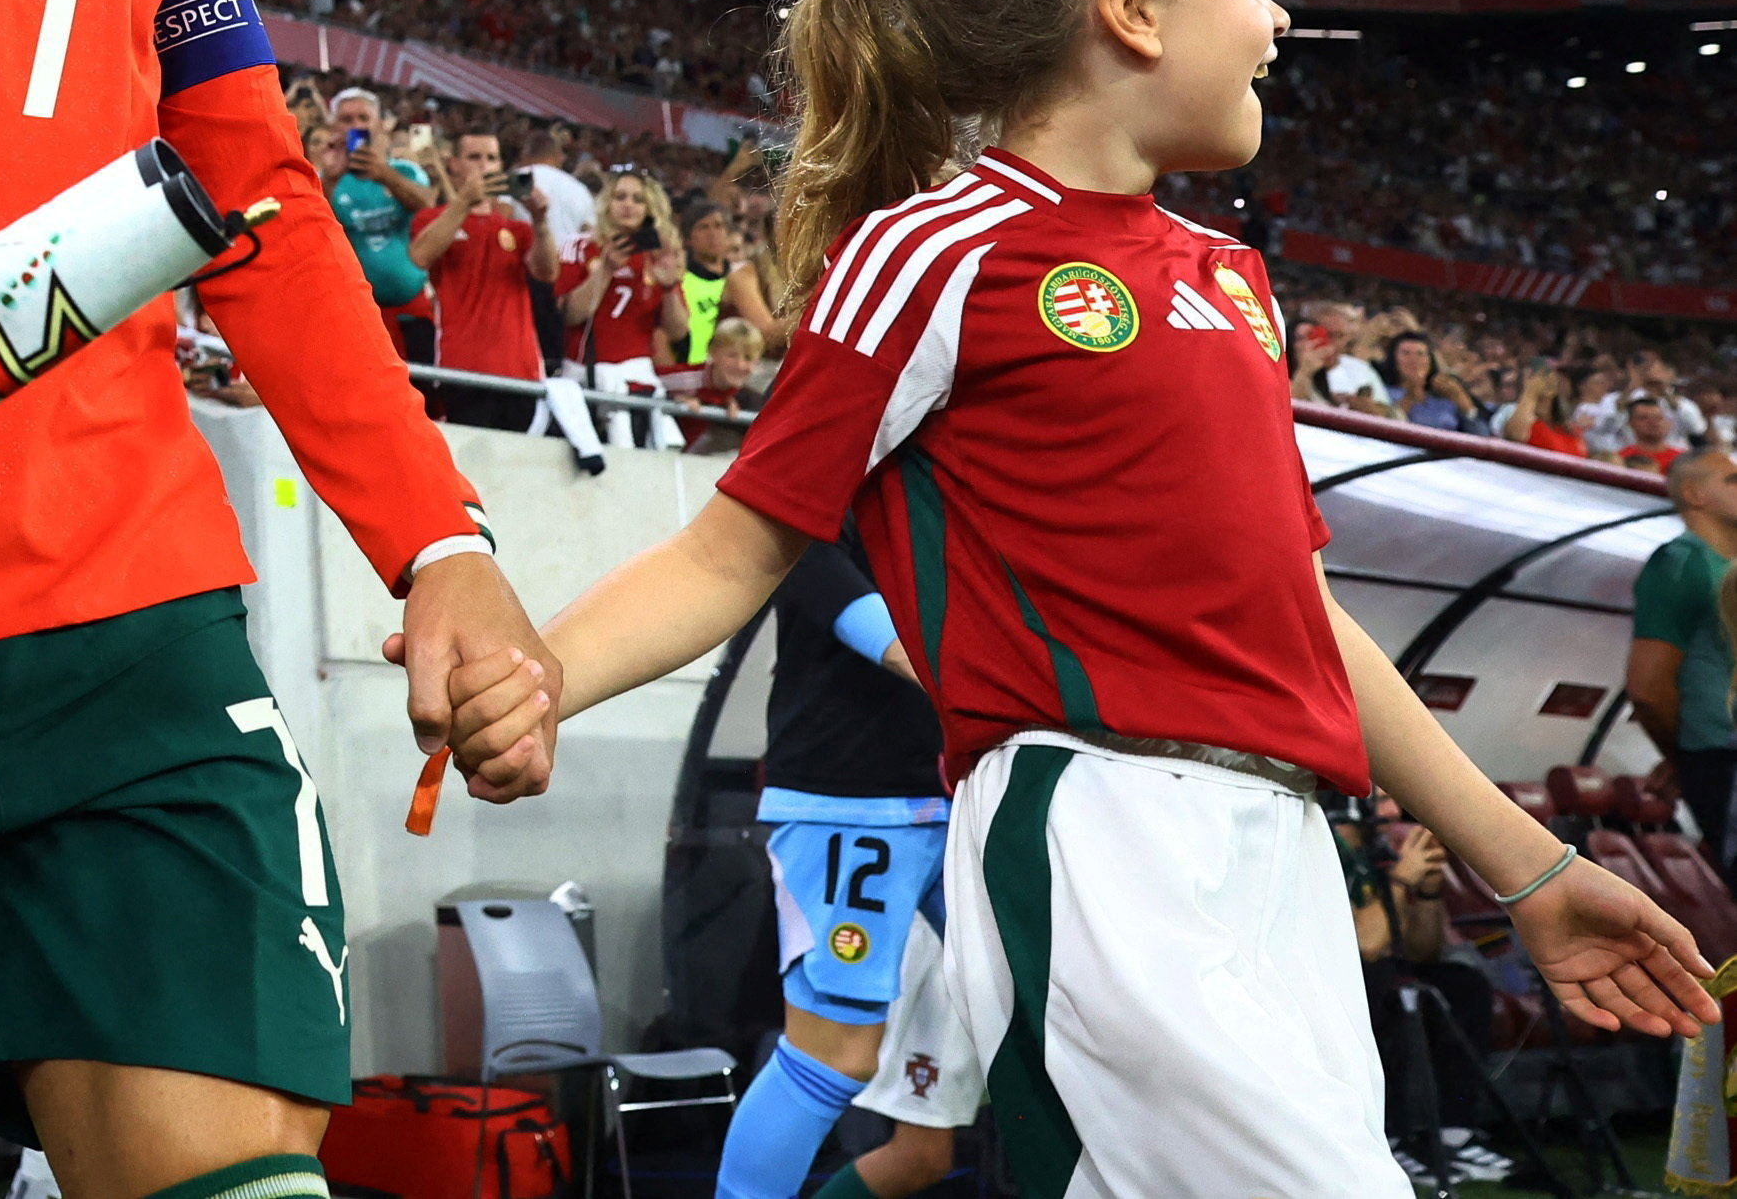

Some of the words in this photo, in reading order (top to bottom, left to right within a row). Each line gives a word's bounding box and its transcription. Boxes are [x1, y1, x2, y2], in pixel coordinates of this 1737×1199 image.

[610, 285, 633, 319] 7
[1045, 302, 1079, 339] MAGYAR
[1091, 335, 1118, 346] 1901
[225, 697, 329, 906] 7
[823, 832, 891, 914] 12
